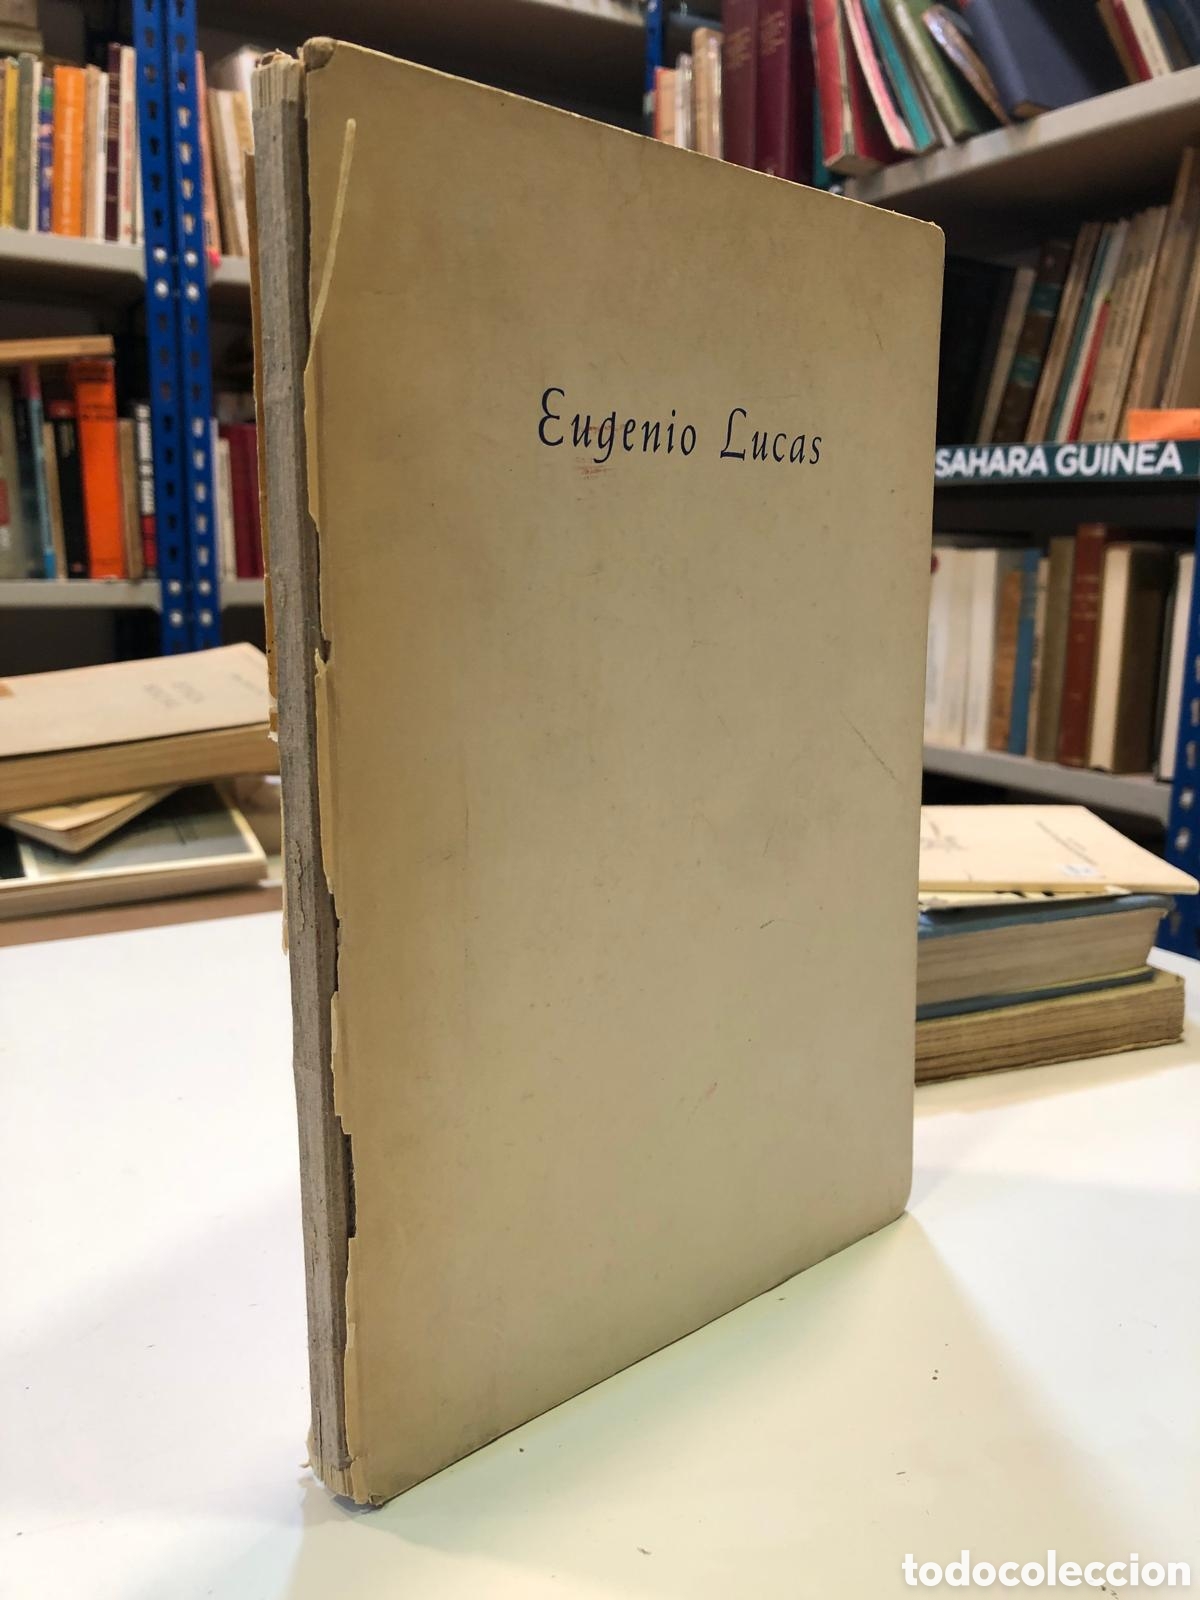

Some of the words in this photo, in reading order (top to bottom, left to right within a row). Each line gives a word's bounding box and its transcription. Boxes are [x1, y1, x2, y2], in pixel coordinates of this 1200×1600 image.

[538, 387, 697, 463] Eugenio
[720, 407, 822, 465] Lucas
[935, 446, 1048, 478] SAHARA
[1054, 440, 1183, 476] GUINEA
